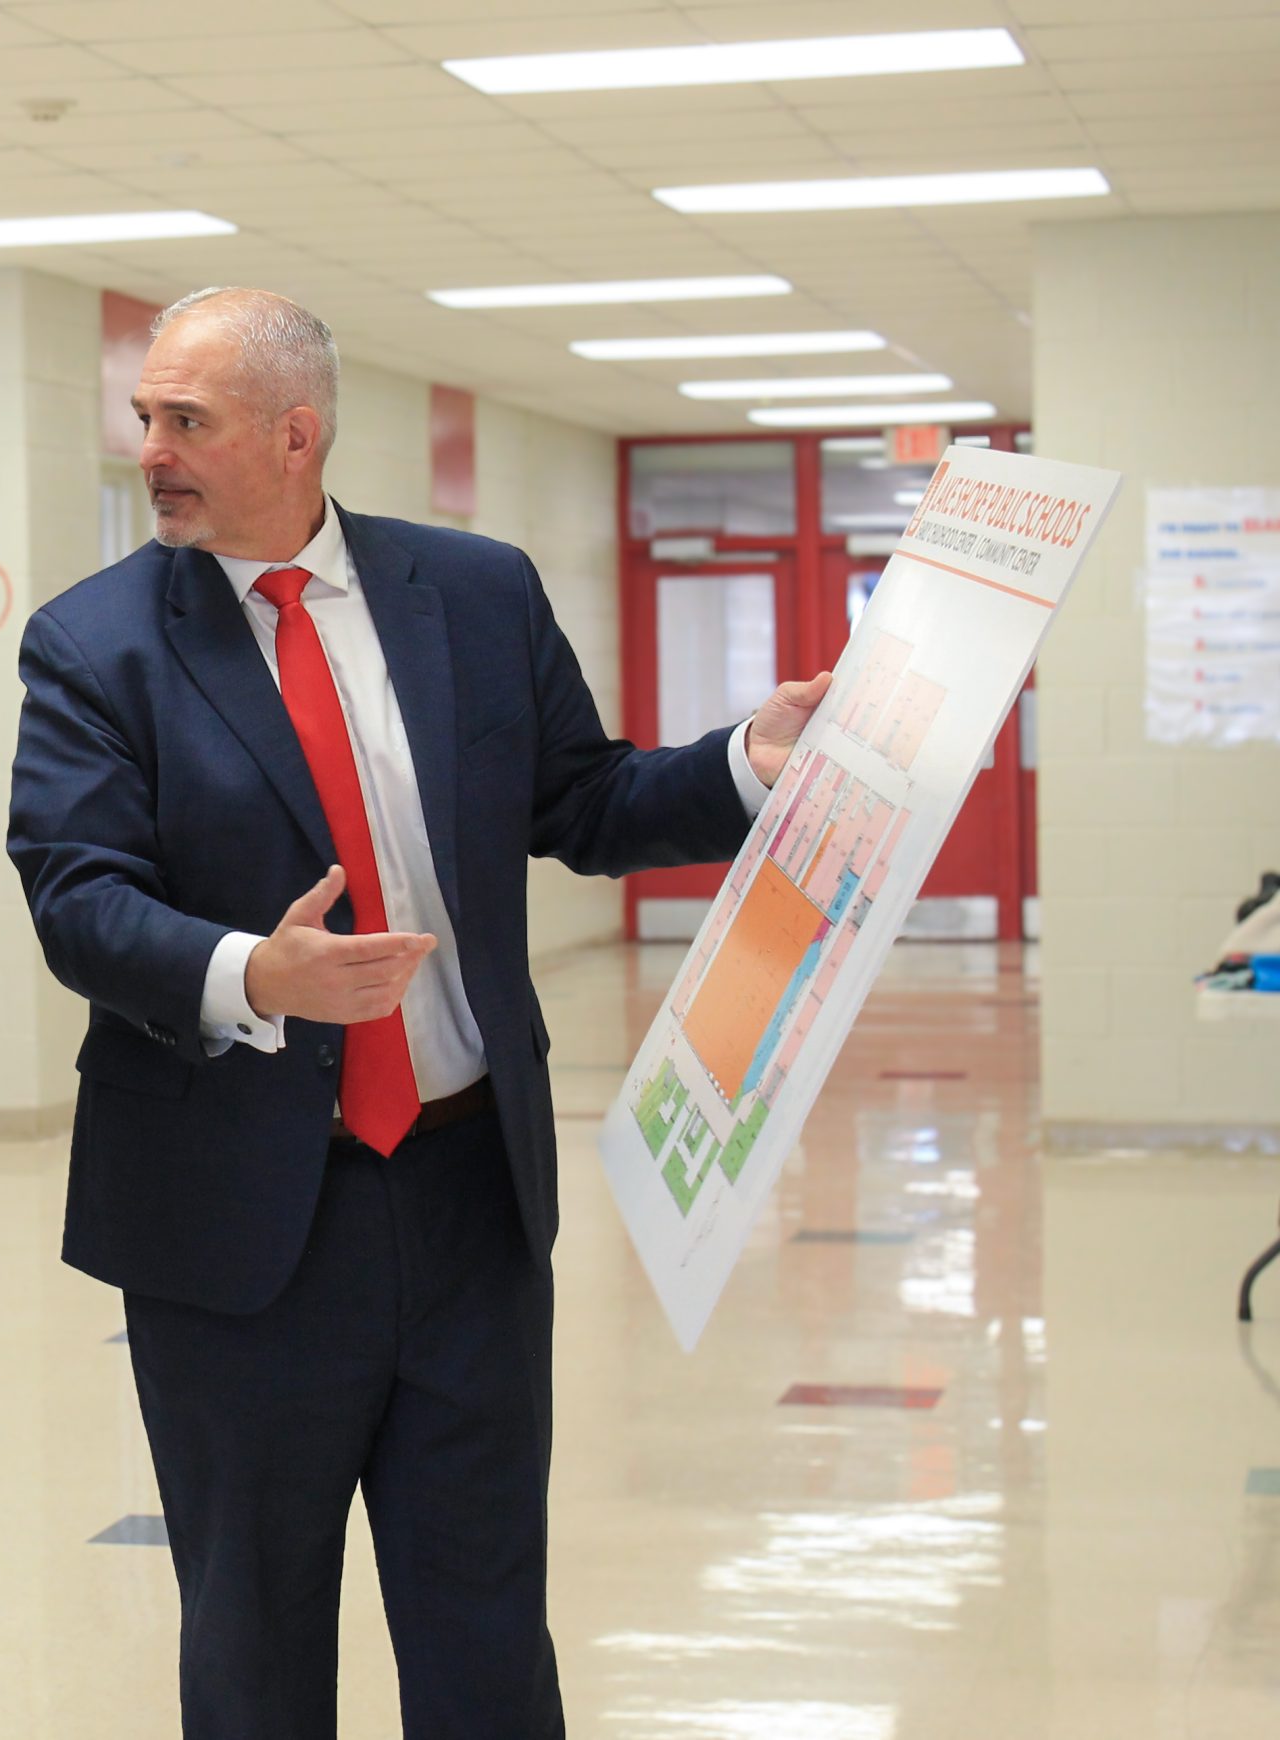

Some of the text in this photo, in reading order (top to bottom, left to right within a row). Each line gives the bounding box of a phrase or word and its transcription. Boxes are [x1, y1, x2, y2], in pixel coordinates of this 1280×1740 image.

[947, 478, 996, 523] SHORE
[979, 485, 1032, 533] PUBLIC
[1015, 493, 1092, 549] SCHOOLS
[1009, 548, 1042, 577] CENTER
